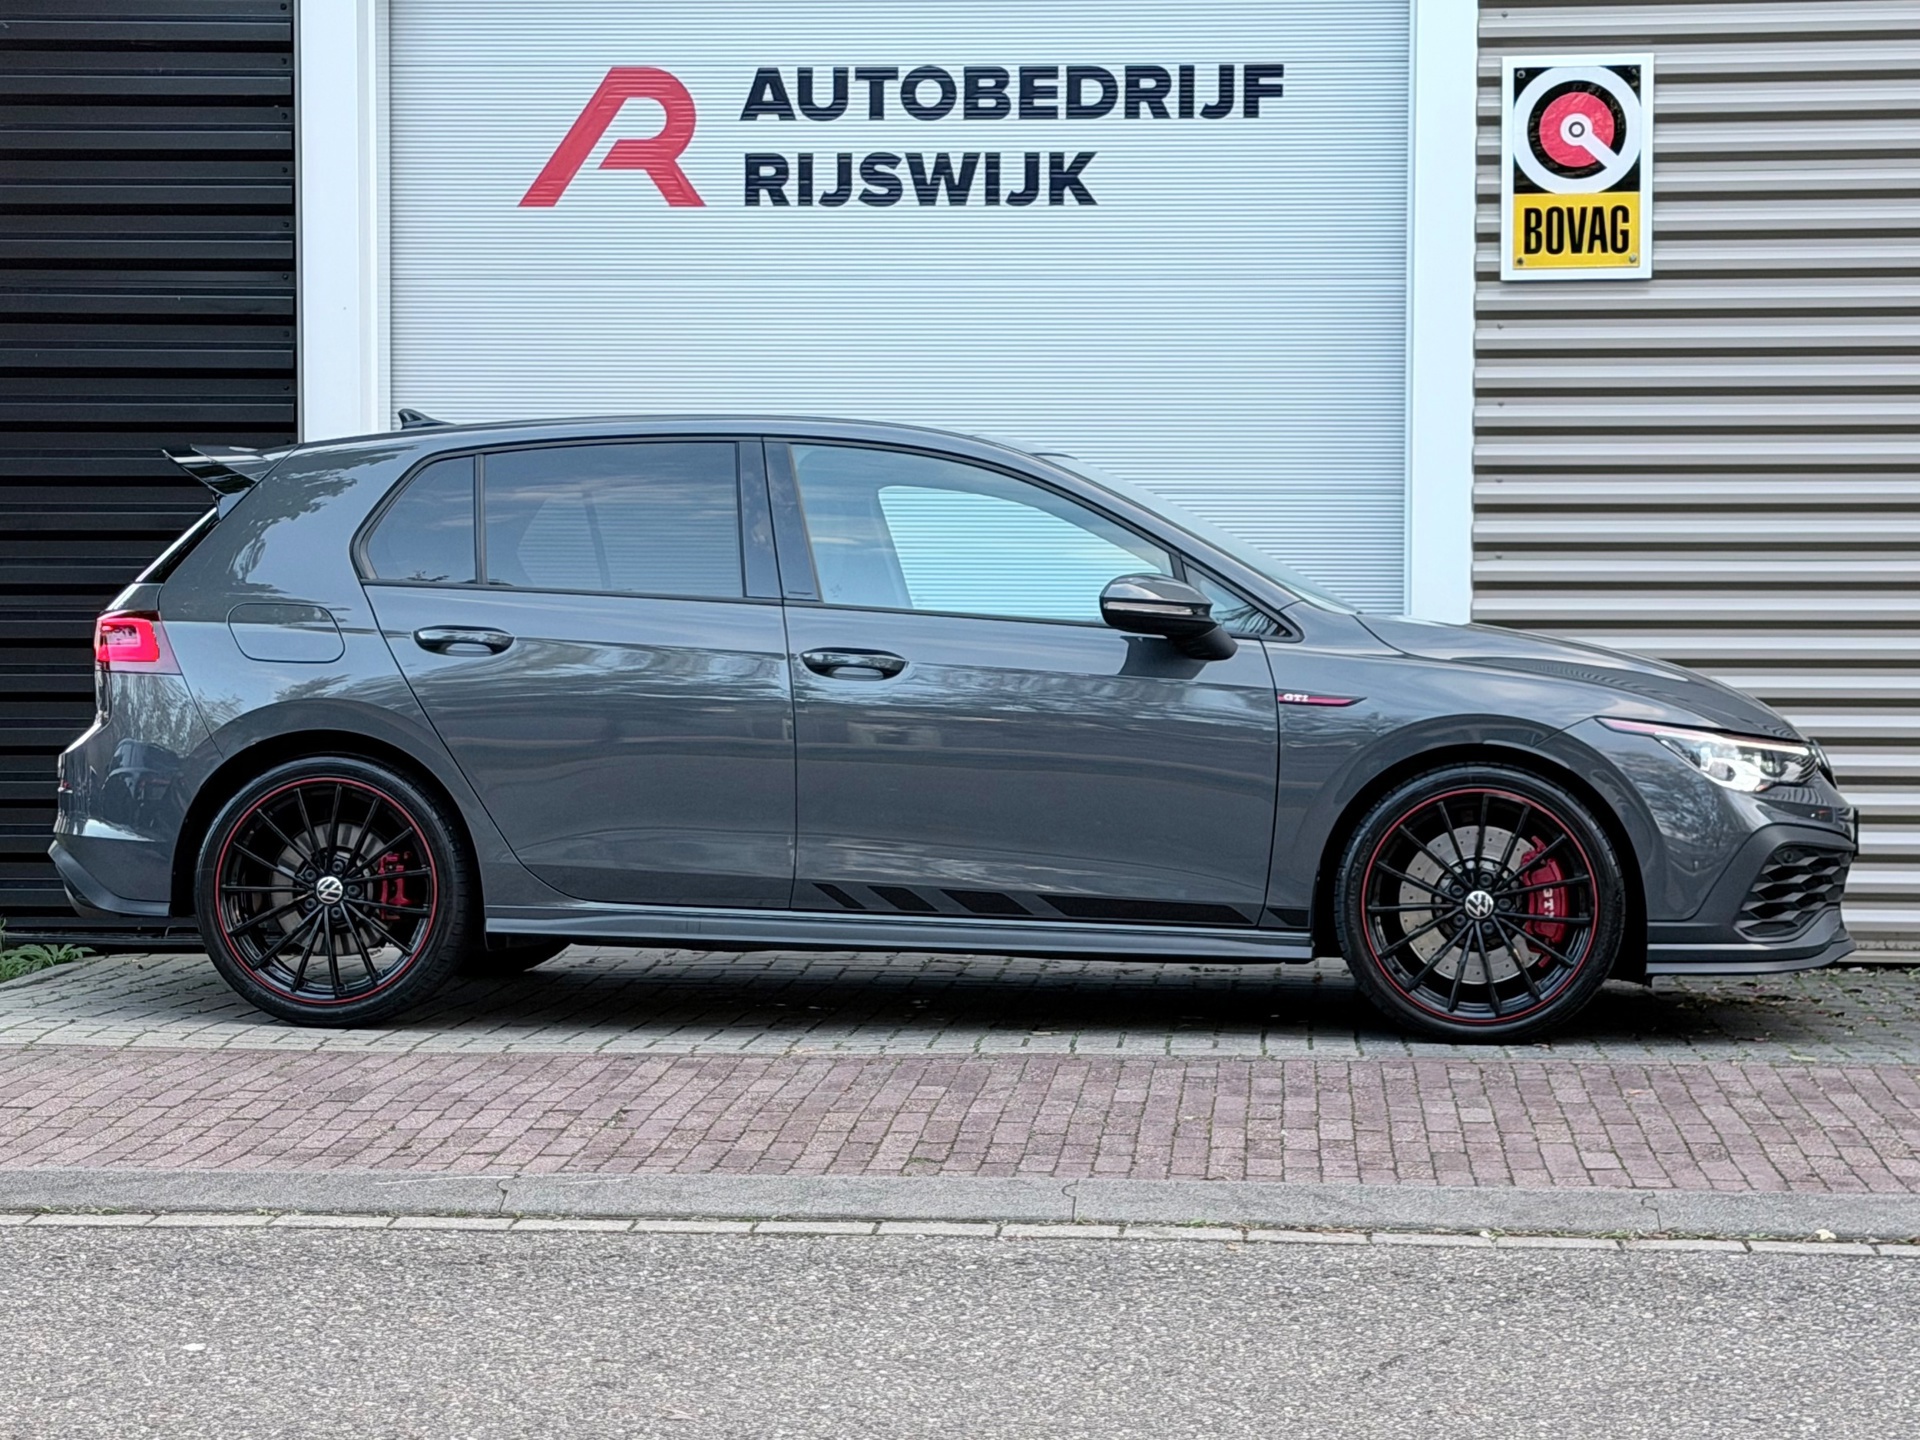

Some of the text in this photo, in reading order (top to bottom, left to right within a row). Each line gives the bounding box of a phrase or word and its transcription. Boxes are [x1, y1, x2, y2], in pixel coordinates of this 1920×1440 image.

[740, 64, 1284, 121] AUTOBEDRIJF
[745, 152, 1097, 207] RIJSWIJK
[1524, 205, 1629, 254] BOVAG
[1283, 693, 1309, 702] GTI
